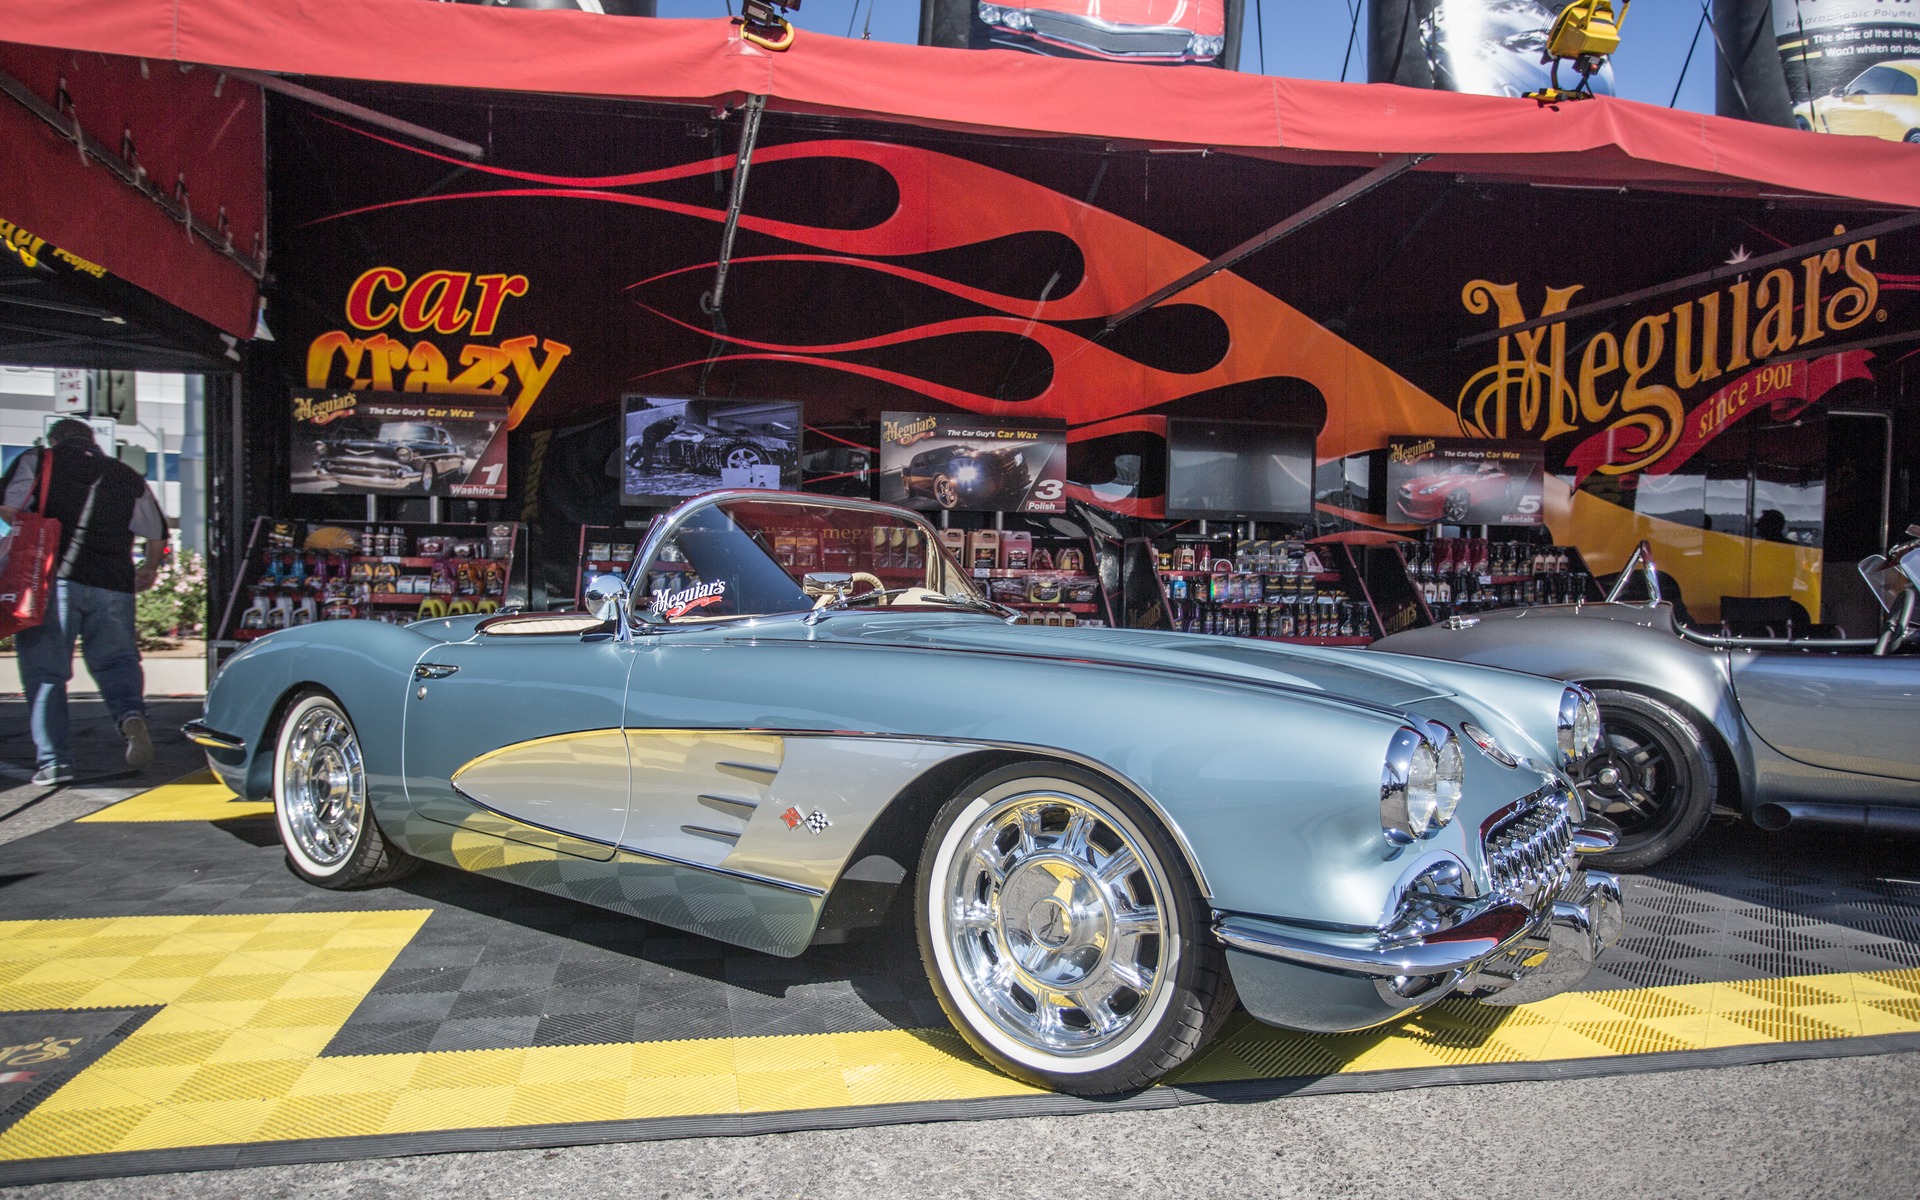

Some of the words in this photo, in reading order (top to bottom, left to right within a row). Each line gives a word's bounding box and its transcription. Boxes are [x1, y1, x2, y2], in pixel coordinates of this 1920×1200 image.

[1813, 34, 1833, 44] The
[1835, 31, 1861, 41] state
[1863, 30, 1874, 39] of
[1875, 29, 1890, 38] the
[1891, 29, 1904, 38] art
[1904, 29, 1913, 38] in
[1825, 45, 1855, 57] Won't
[1857, 44, 1888, 53] whiten
[1890, 45, 1902, 53] on
[345, 266, 529, 336] car
[1457, 224, 1879, 475] Meguiar's
[61, 370, 80, 379] ANY
[60, 380, 82, 390] TIME
[294, 393, 357, 424] Meguiar's
[1699, 382, 1749, 439] since
[1753, 363, 1793, 397] 1901
[369, 407, 385, 415] The
[386, 408, 401, 416] Car
[402, 408, 426, 417] Guy's
[427, 408, 447, 417] Car
[450, 409, 475, 418] Wax
[883, 415, 937, 444] Meguiar's
[975, 430, 996, 438] Guy's
[997, 430, 1015, 438] Car
[1017, 430, 1037, 439] Wax
[1390, 439, 1436, 465] Meguiar's
[1486, 451, 1500, 459] Car
[481, 463, 504, 485] 1
[451, 486, 495, 496] Washing
[1035, 479, 1064, 500] 3
[1028, 502, 1056, 511] Polish
[1517, 495, 1541, 514] 5
[1501, 515, 1535, 523] Maintain
[651, 579, 726, 617] Meguiar's
